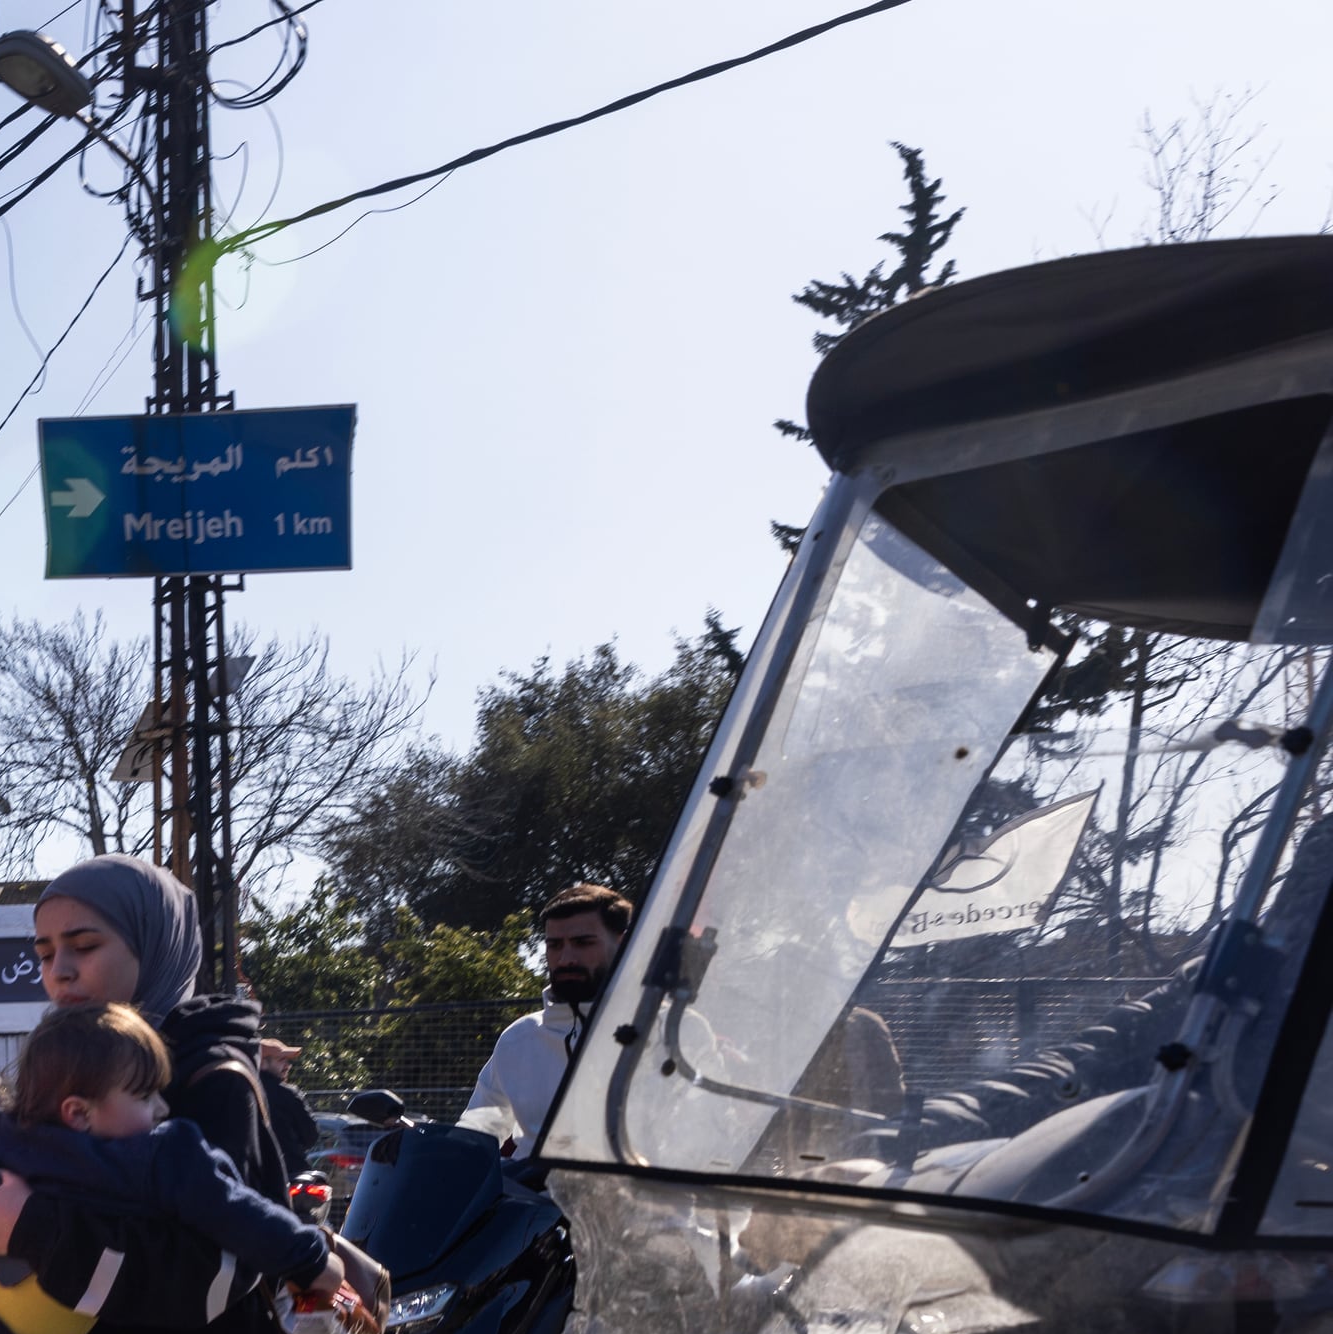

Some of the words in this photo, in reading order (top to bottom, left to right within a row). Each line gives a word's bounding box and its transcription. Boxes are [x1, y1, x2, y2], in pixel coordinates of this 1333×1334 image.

[120, 443, 243, 483] المريجة
[123, 509, 244, 544] Mreijeh
[274, 512, 285, 536] 1
[293, 512, 332, 535] km
